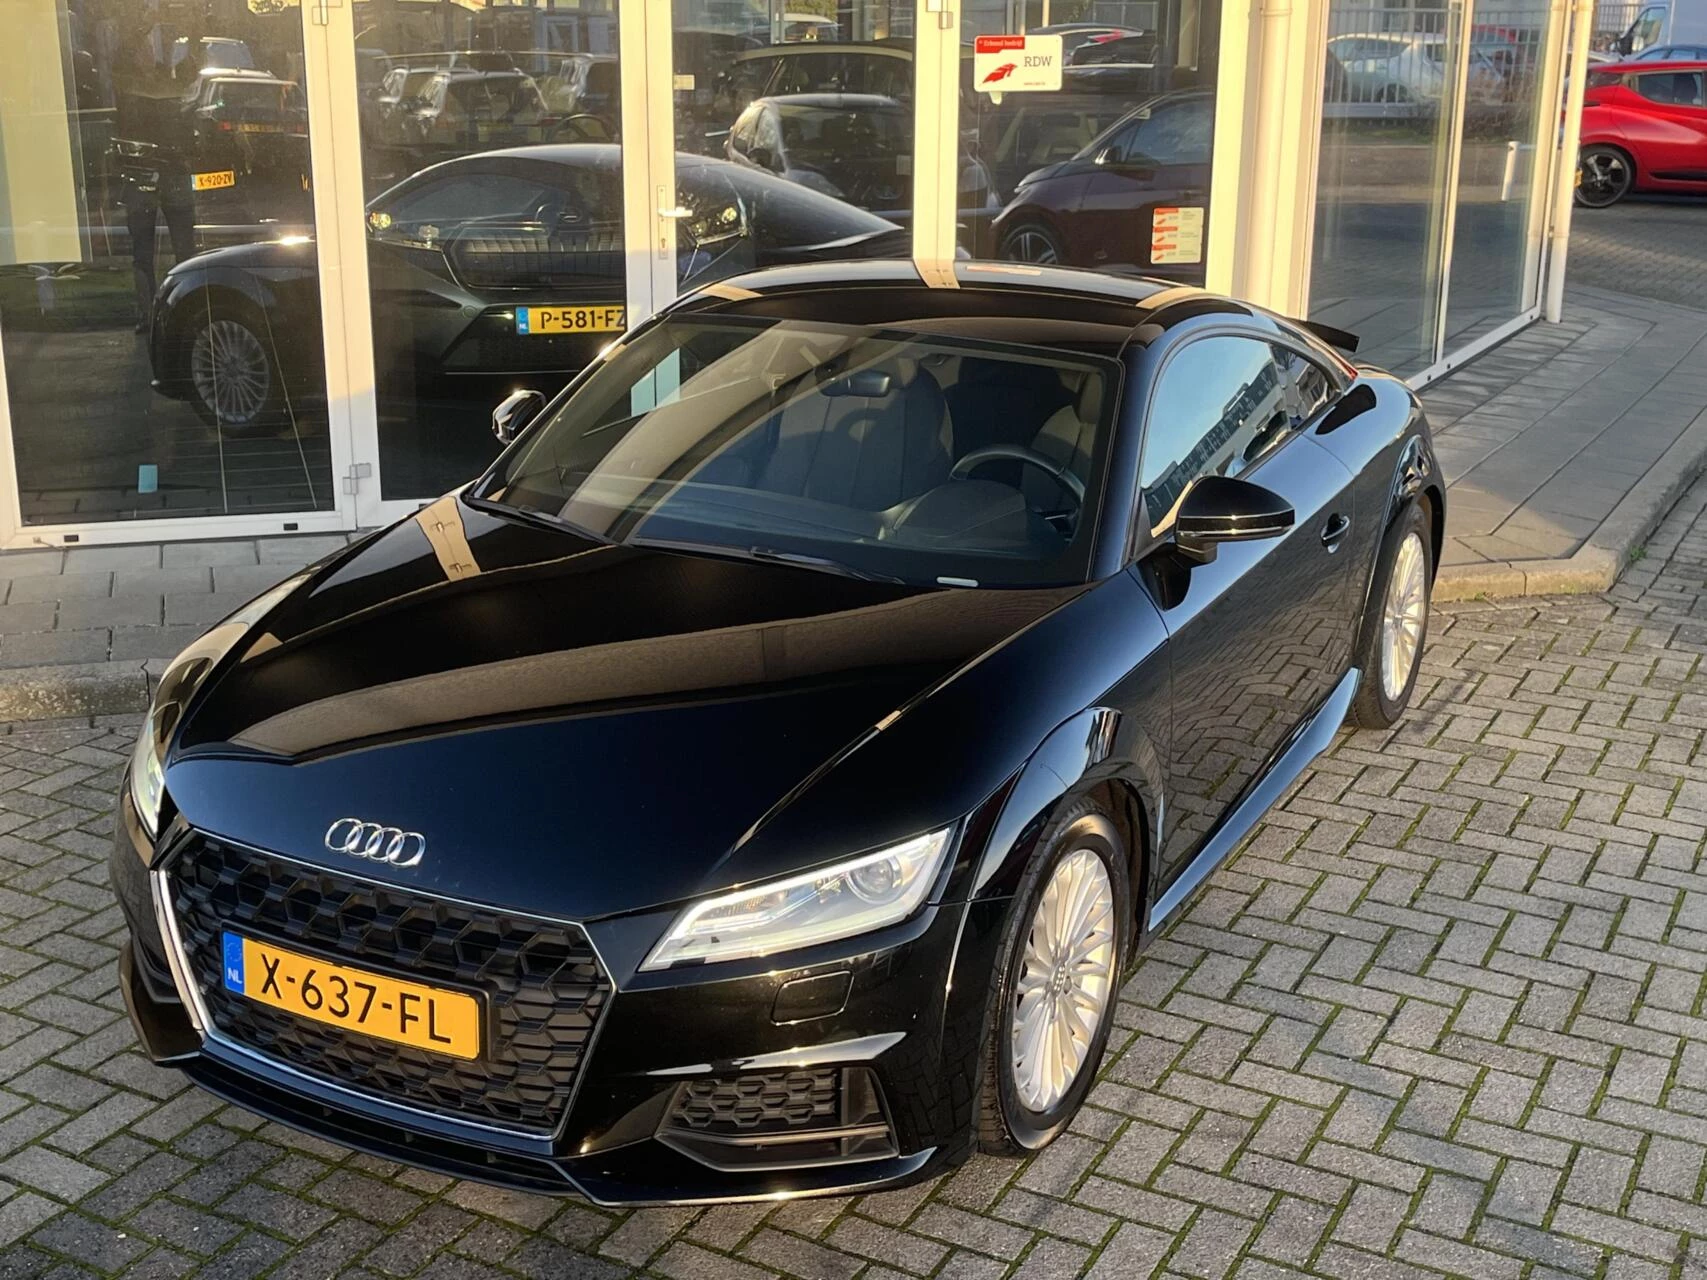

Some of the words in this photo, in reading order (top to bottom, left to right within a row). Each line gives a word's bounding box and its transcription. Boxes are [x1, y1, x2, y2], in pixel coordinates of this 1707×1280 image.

[1024, 56, 1052, 67] RDW
[227, 967, 243, 985] NL
[261, 953, 452, 1044] X-637-FL
